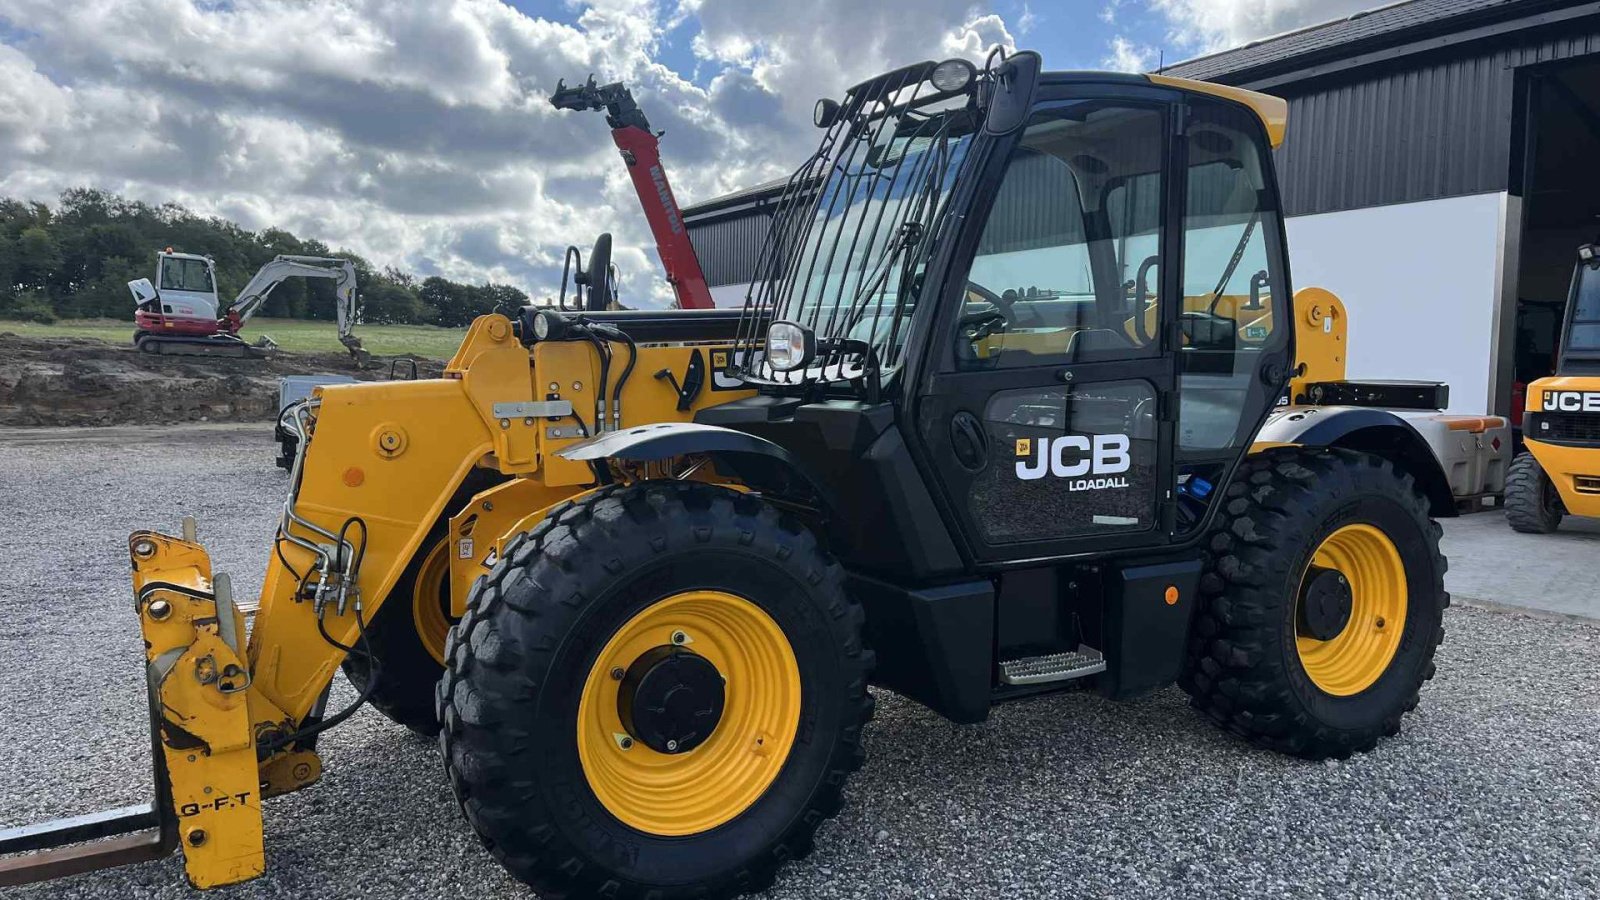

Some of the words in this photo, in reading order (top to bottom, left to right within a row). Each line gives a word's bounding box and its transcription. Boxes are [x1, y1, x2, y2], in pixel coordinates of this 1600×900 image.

[650, 165, 682, 234] MANITOU
[1015, 434, 1131, 480] JCB
[1069, 477, 1130, 492] LOADALL
